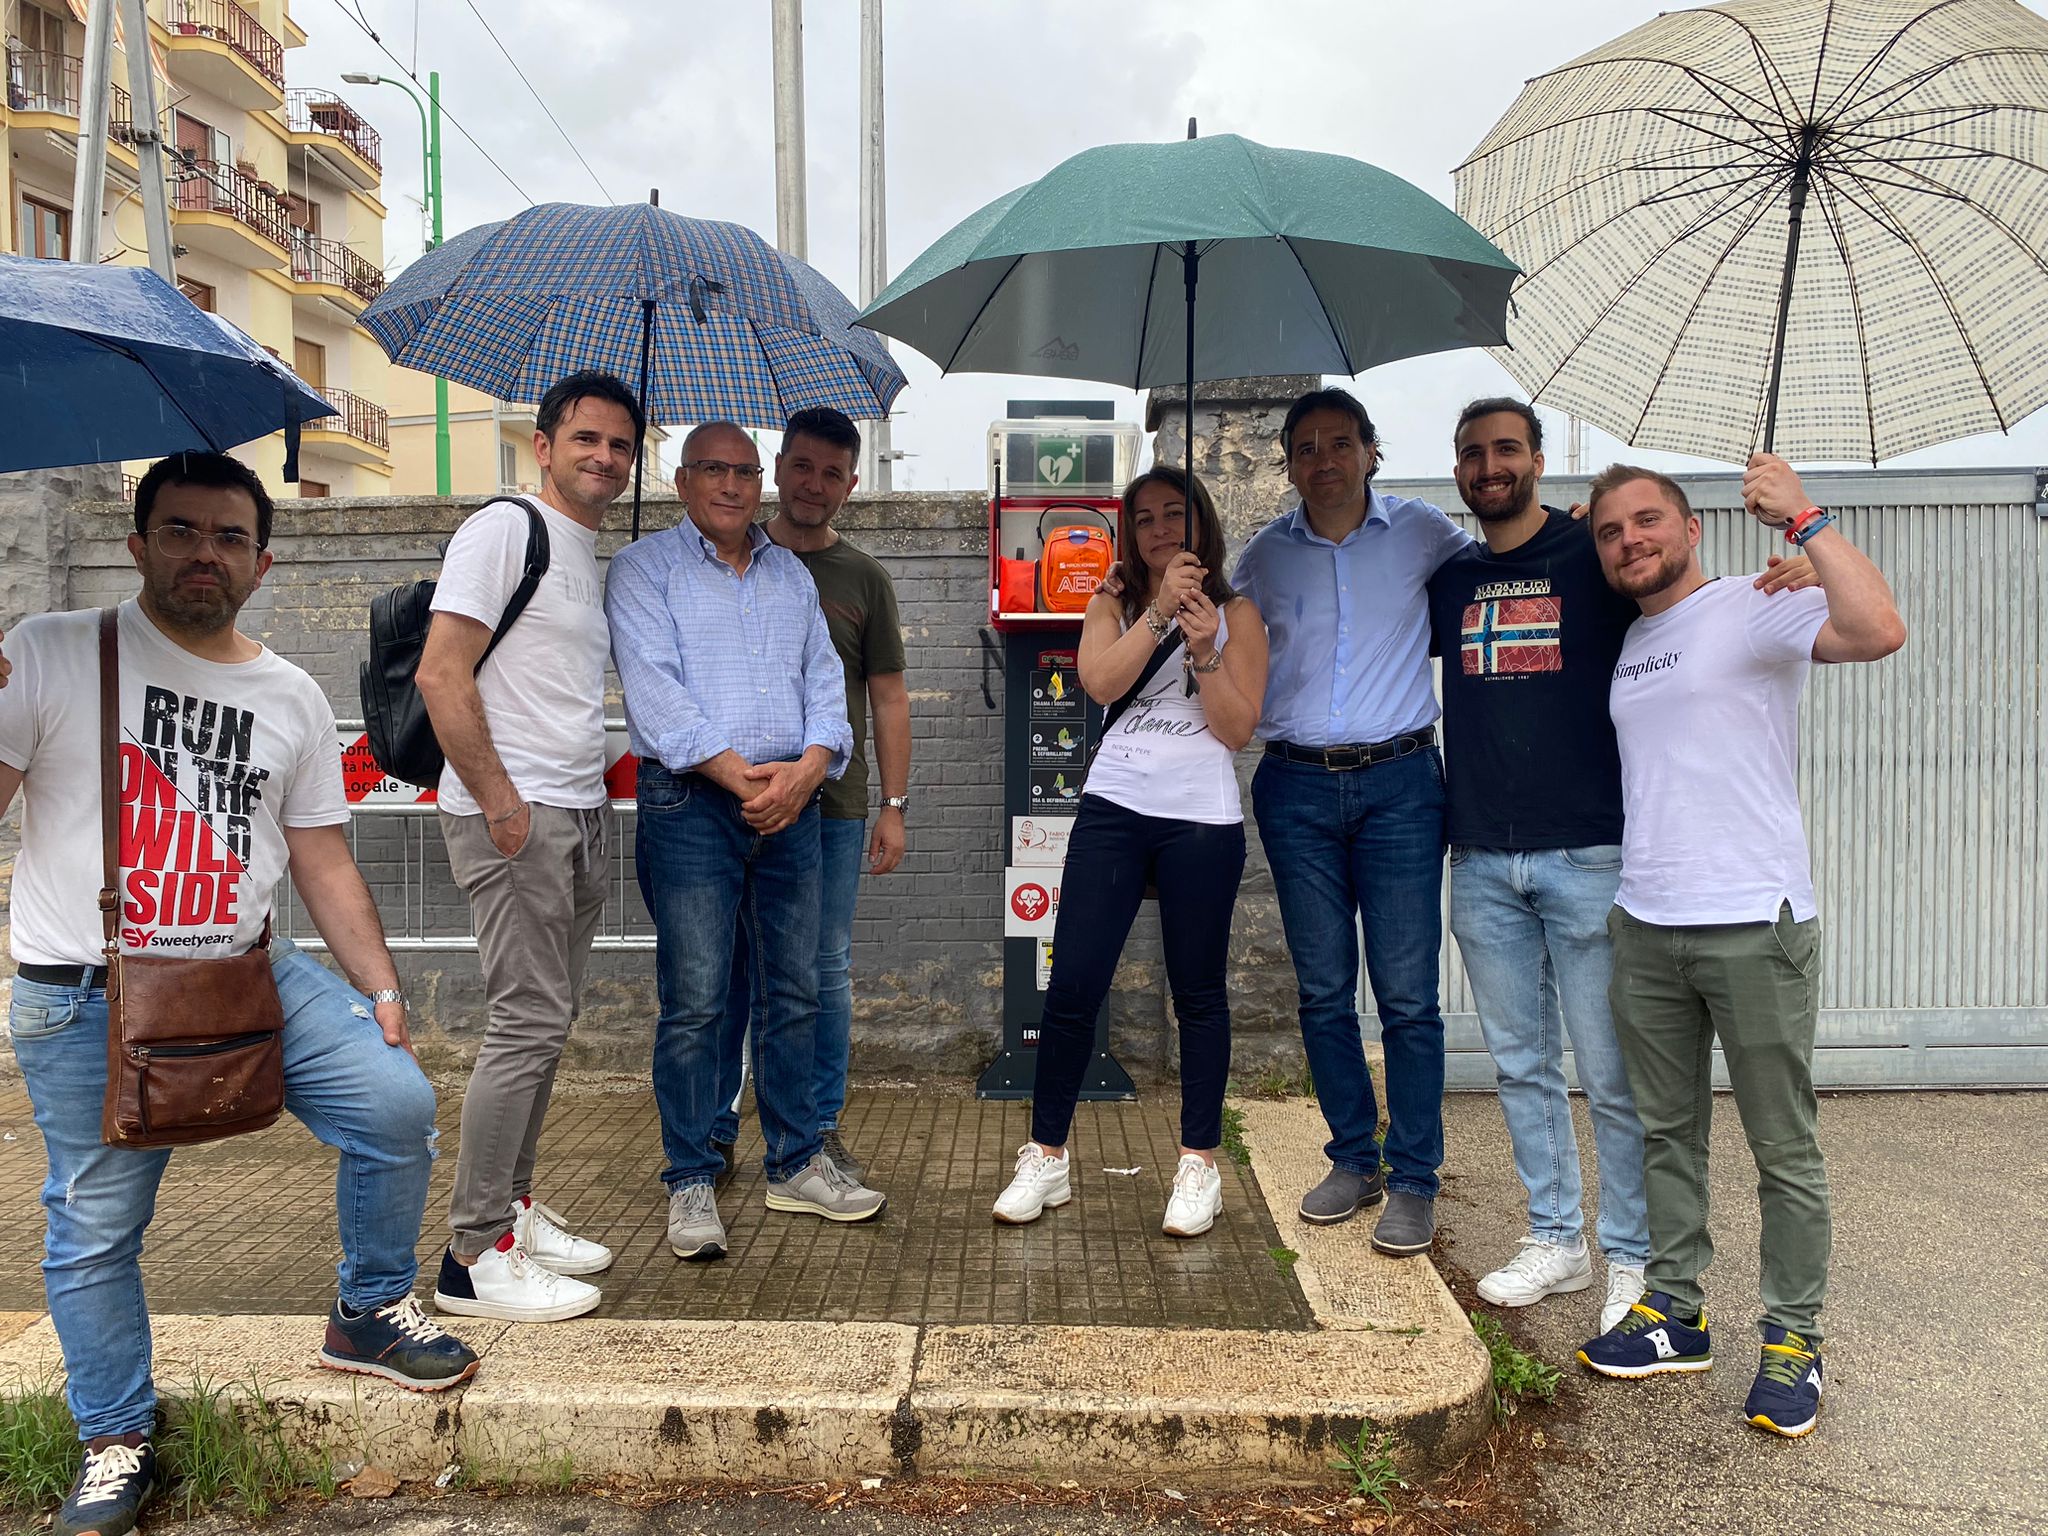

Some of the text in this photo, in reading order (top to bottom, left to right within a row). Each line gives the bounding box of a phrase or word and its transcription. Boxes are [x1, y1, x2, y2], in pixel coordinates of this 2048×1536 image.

[1057, 576, 1102, 593] AED
[1475, 579, 1550, 599] NAPAPIJRI
[1613, 651, 1682, 681] Simplicity
[141, 684, 255, 763] RUN
[124, 869, 240, 926] SIDE
[151, 934, 235, 949] sweetyears
